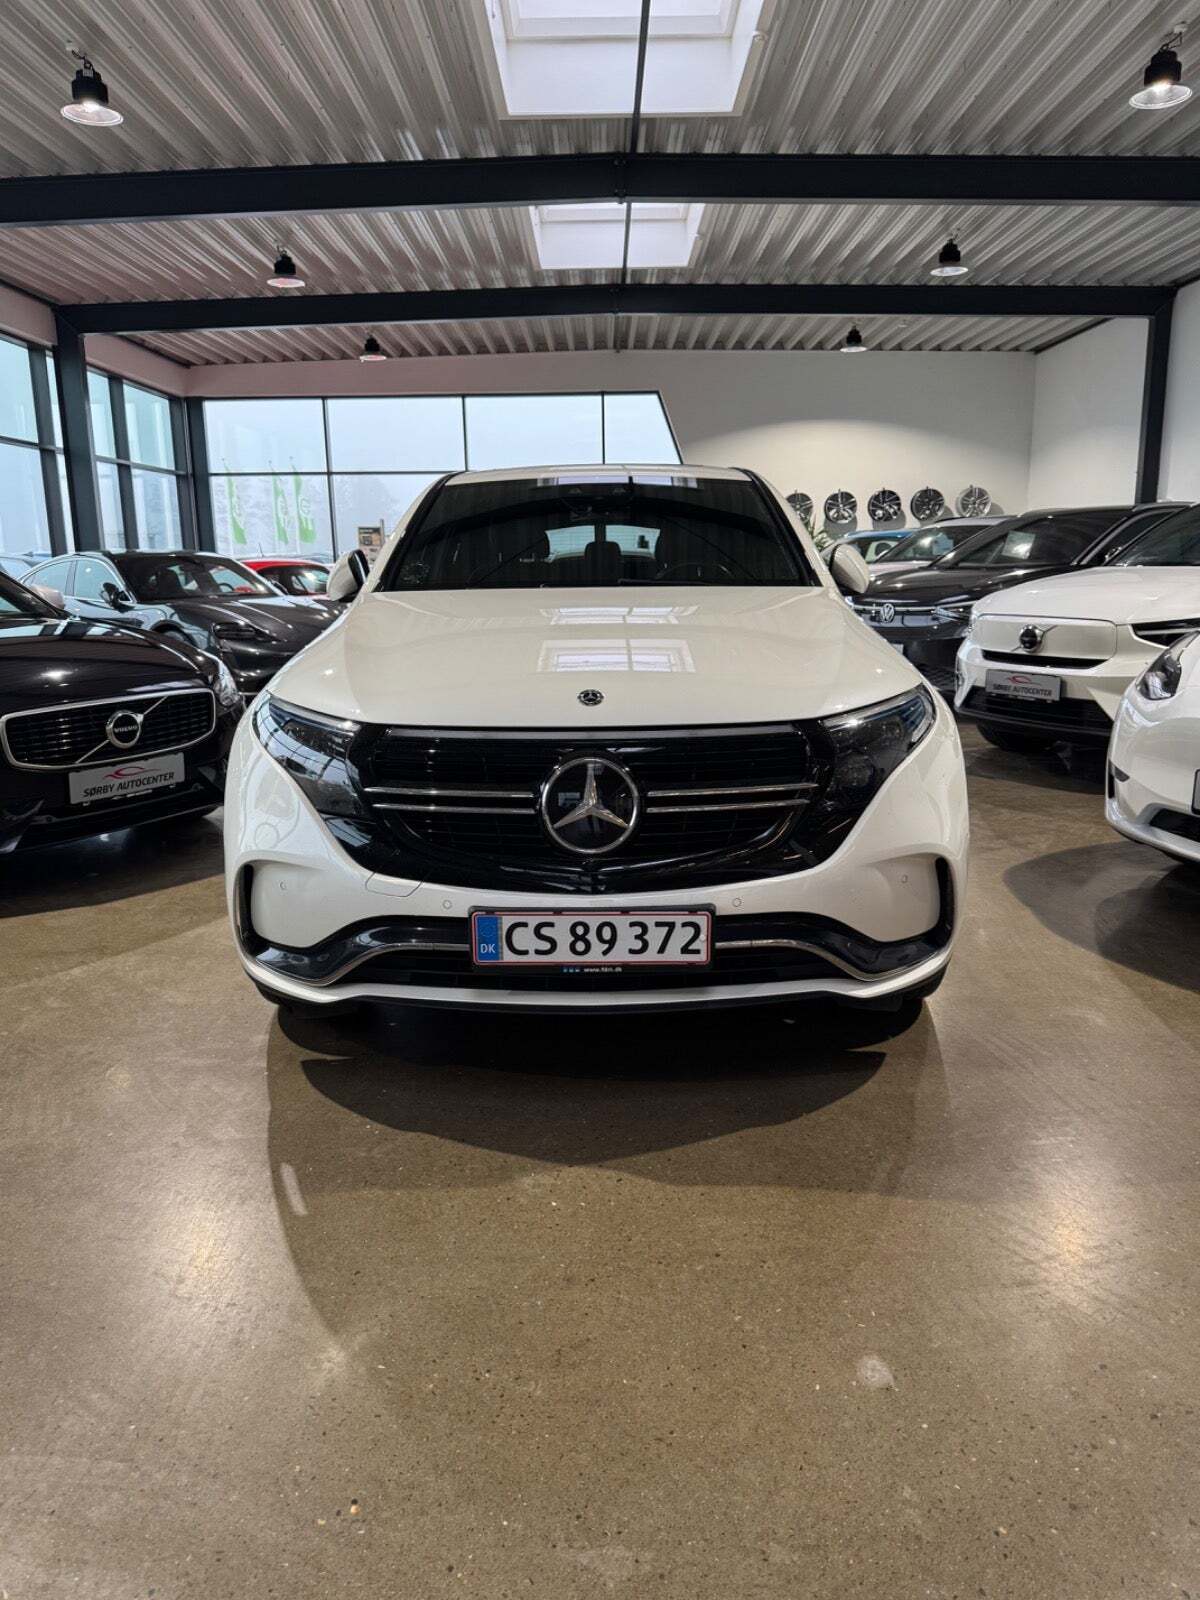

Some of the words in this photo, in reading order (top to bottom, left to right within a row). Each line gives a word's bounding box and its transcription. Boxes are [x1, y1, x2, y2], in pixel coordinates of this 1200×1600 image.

[1012, 686, 1053, 697] AUTOCENTER
[83, 784, 114, 798] SØRBY
[116, 772, 174, 791] AUTOCENTER
[480, 944, 496, 953] DK
[505, 921, 558, 956] CS
[569, 921, 618, 957] 89
[628, 920, 702, 955] 372
